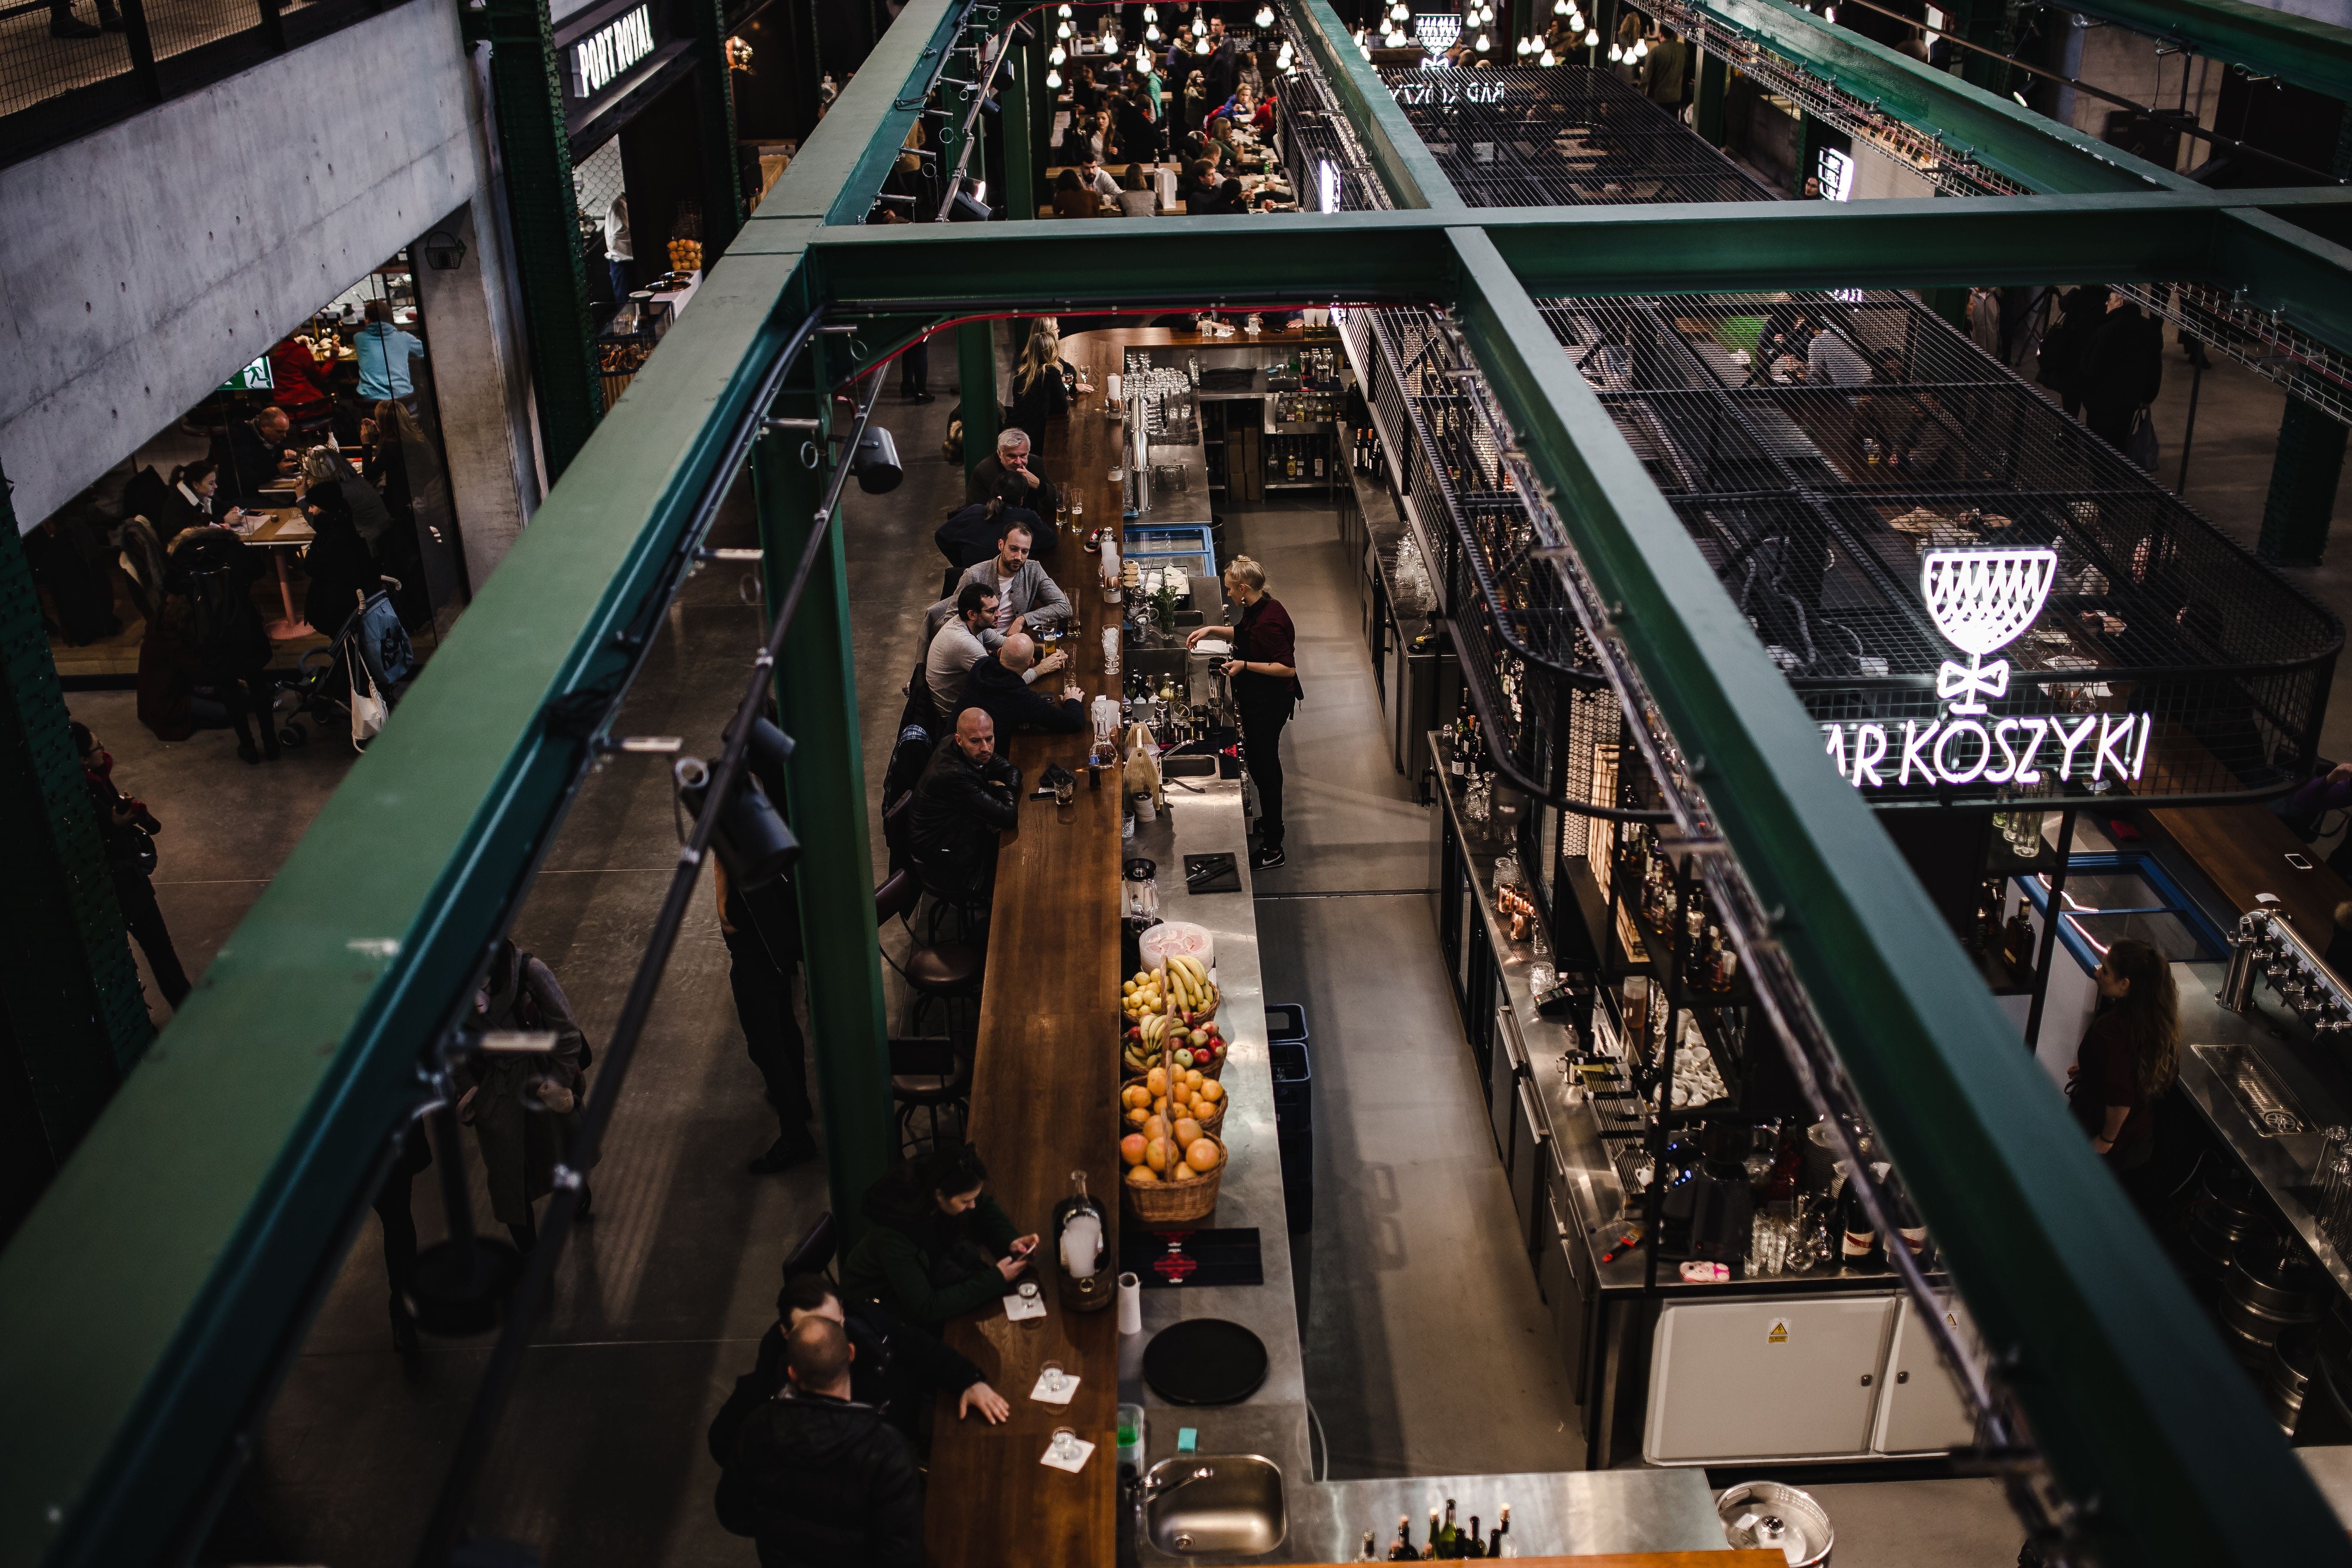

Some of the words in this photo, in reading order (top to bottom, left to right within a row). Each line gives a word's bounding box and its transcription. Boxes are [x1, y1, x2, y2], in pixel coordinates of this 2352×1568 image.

[577, 26, 616, 98] PORT
[613, 4, 654, 73] ROYAL
[1826, 723, 1887, 787] AR
[1897, 712, 2151, 786] KOSZYKI
